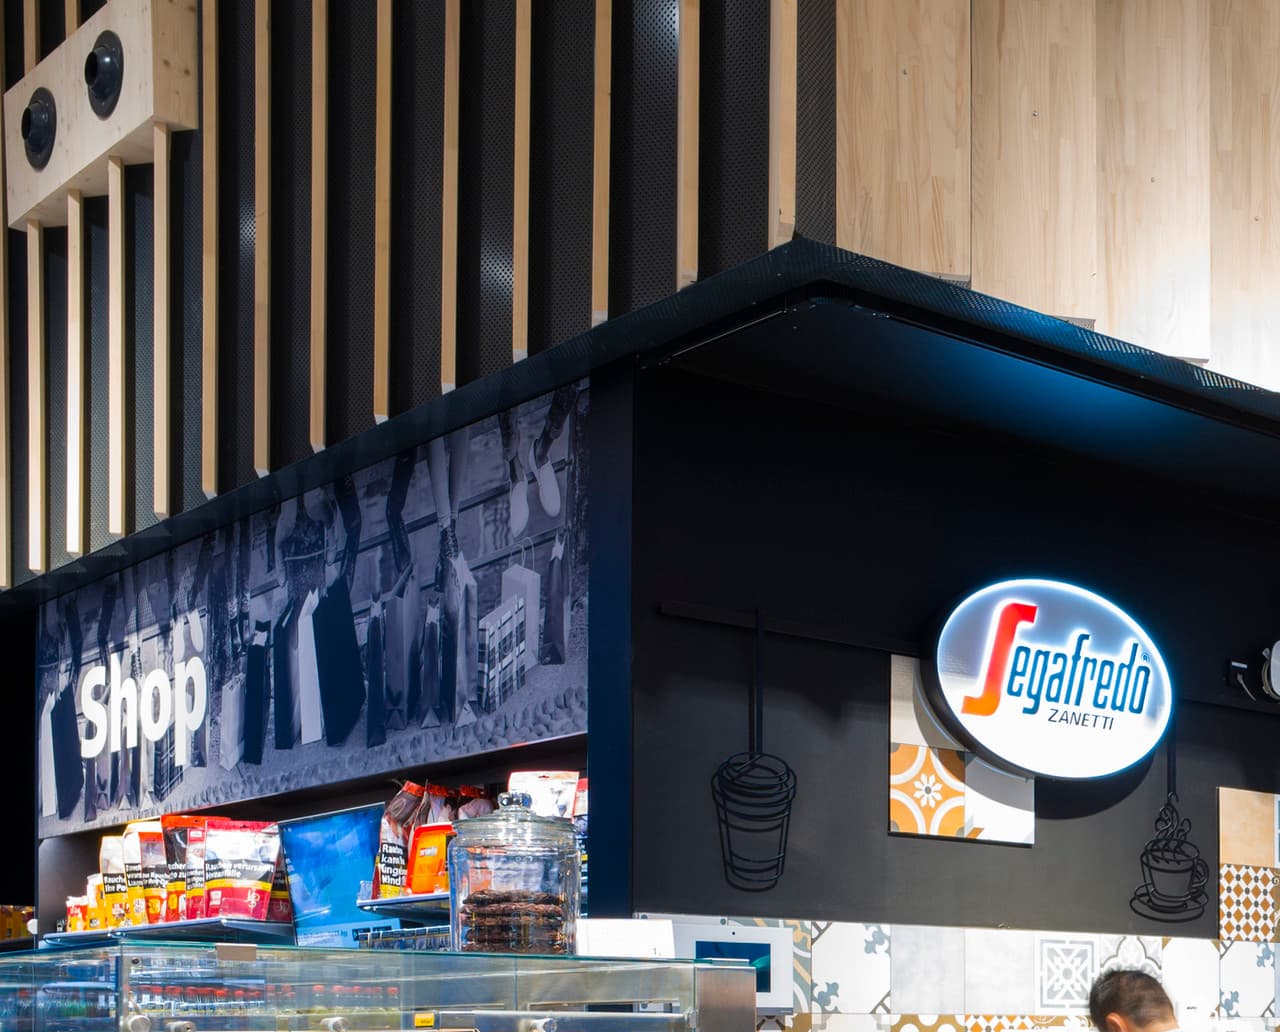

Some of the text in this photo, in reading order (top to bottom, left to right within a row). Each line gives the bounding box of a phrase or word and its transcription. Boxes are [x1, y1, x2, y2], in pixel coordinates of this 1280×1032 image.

[80, 652, 208, 768] shop
[961, 602, 1151, 717] Segafredo
[1047, 708, 1114, 731] ZANETTI
